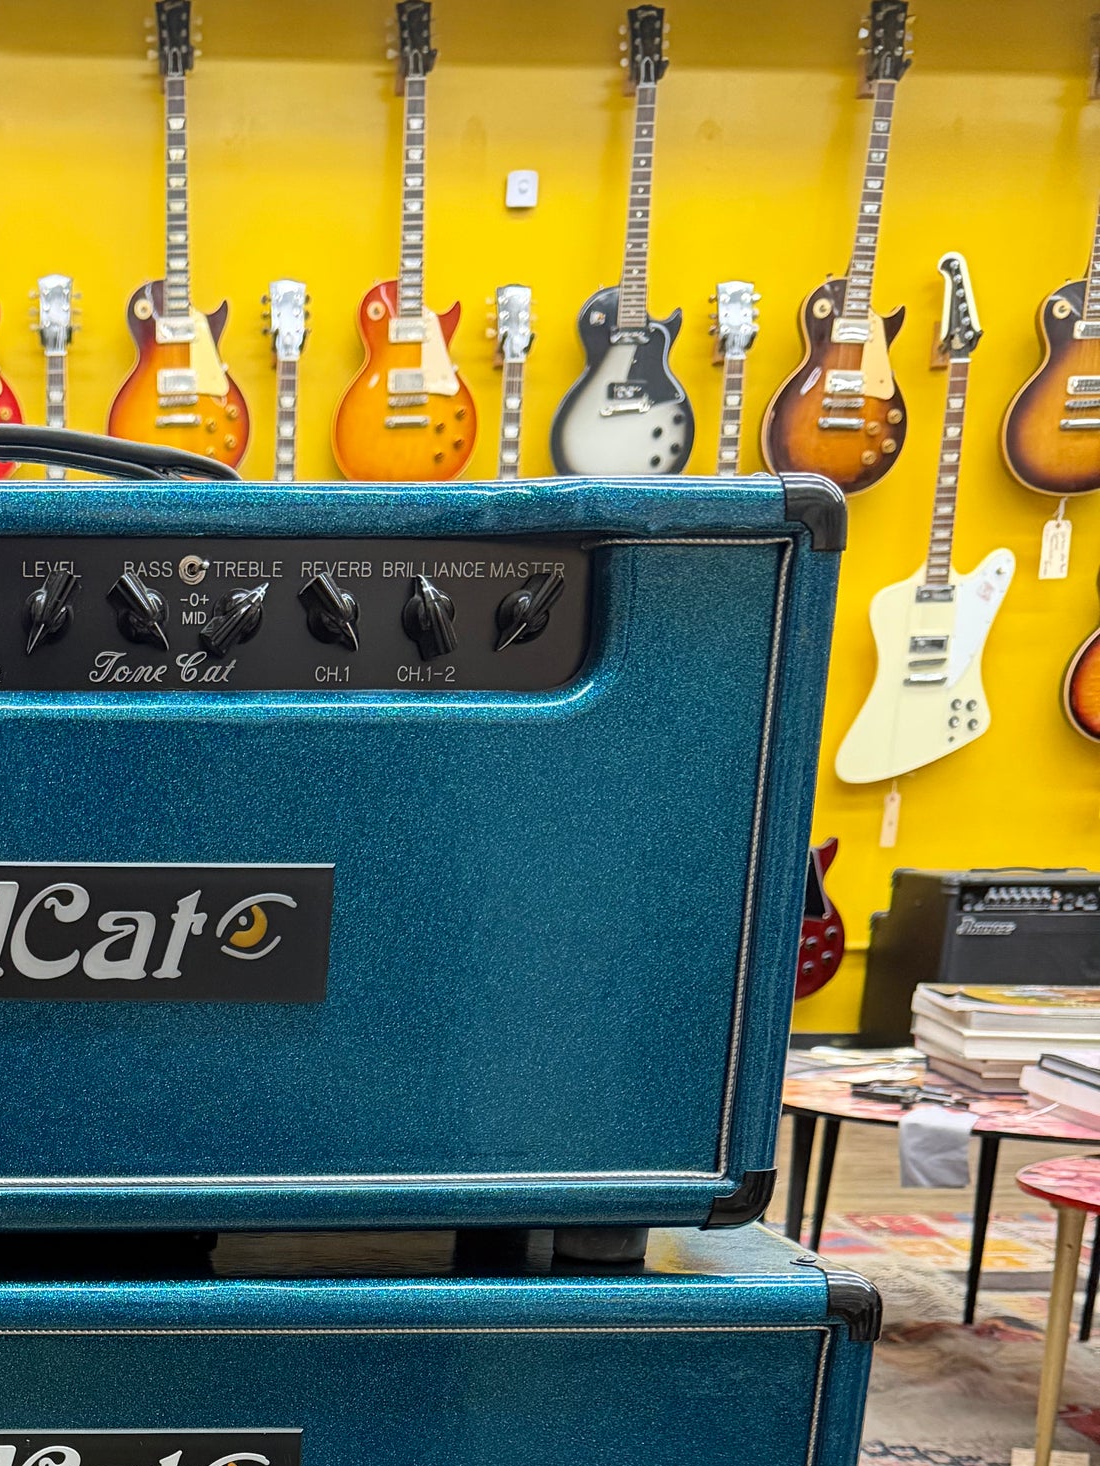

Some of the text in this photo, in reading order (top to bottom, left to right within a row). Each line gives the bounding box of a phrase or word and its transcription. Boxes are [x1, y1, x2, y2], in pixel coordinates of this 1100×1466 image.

[124, 561, 173, 578] BASS
[214, 561, 283, 578] TREBLE
[301, 561, 372, 578] REVERB
[382, 561, 486, 578] BRILLIANCE
[182, 611, 207, 625] MID
[89, 651, 236, 683] Tone Cat
[315, 666, 350, 683] CH.1
[397, 666, 456, 683] CH.1-2
